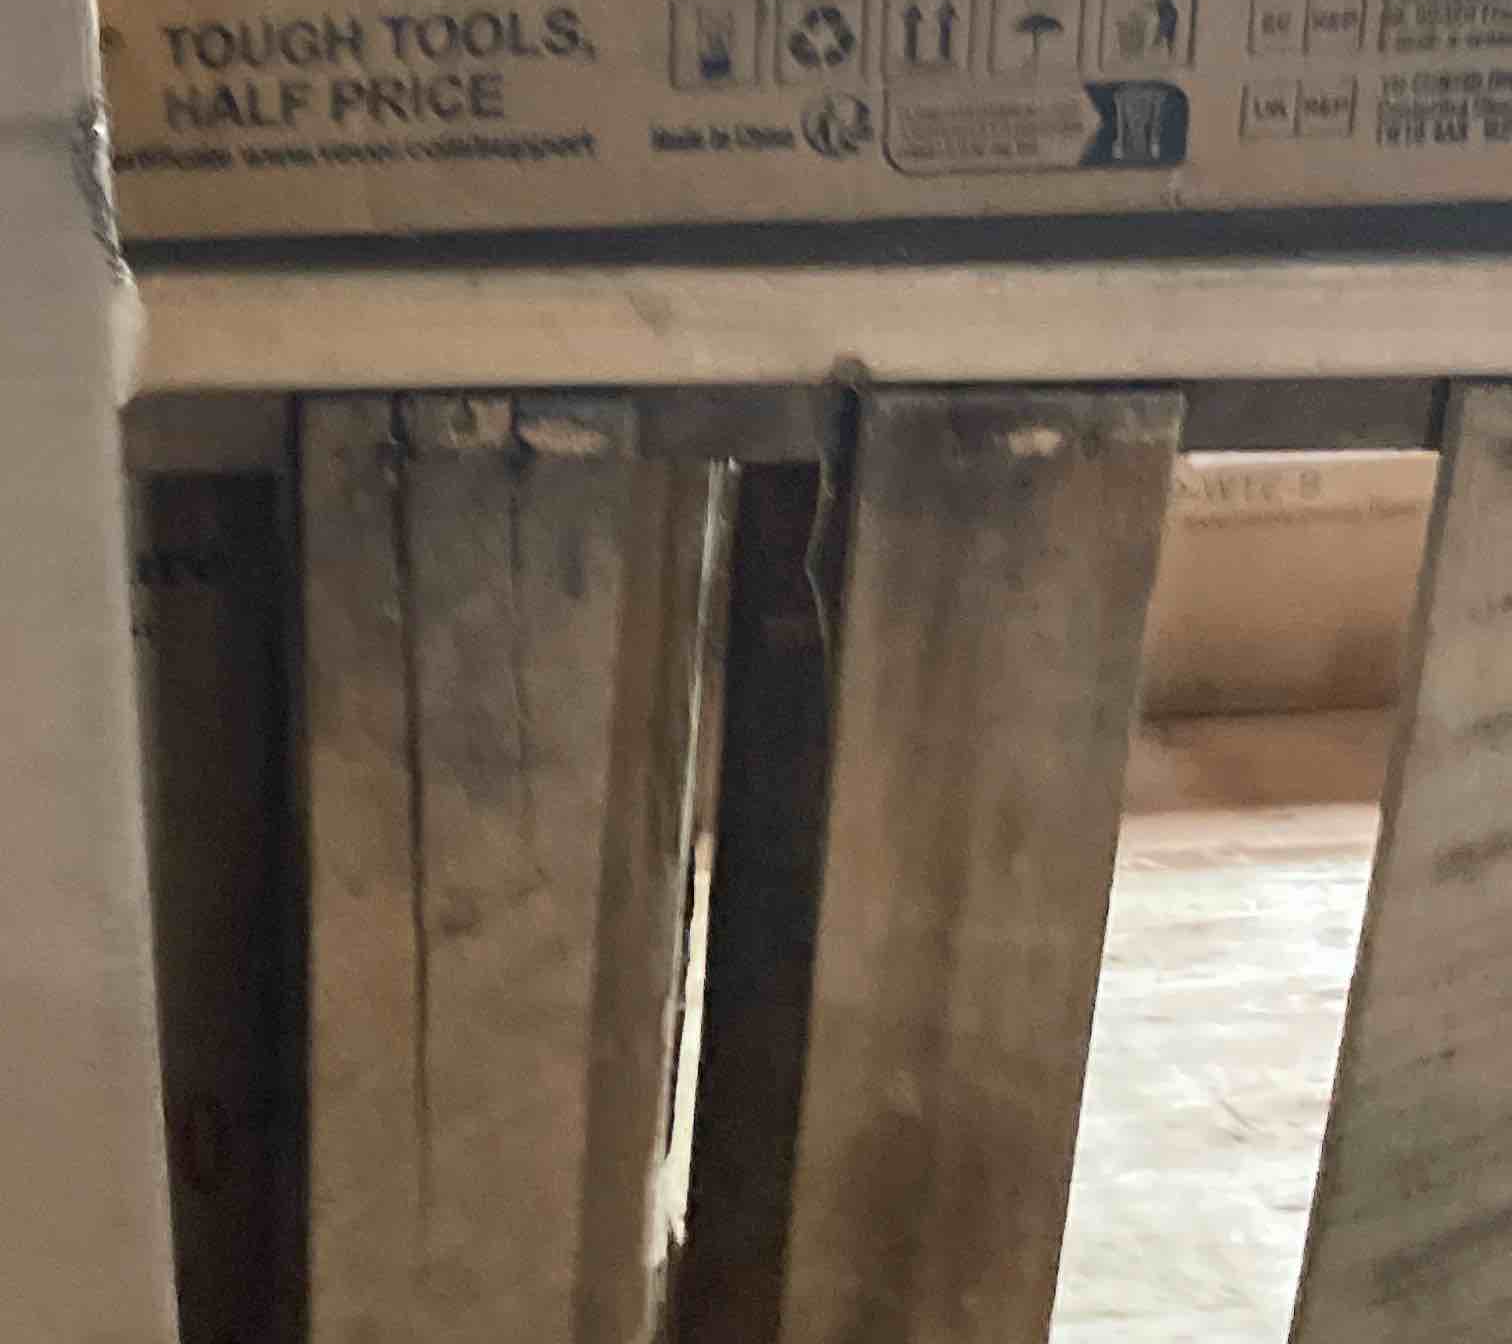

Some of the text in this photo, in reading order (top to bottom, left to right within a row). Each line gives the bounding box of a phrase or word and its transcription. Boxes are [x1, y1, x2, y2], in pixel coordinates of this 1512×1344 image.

[163, 13, 364, 69] TOUGH
[165, 73, 506, 130] HALF PRICE
